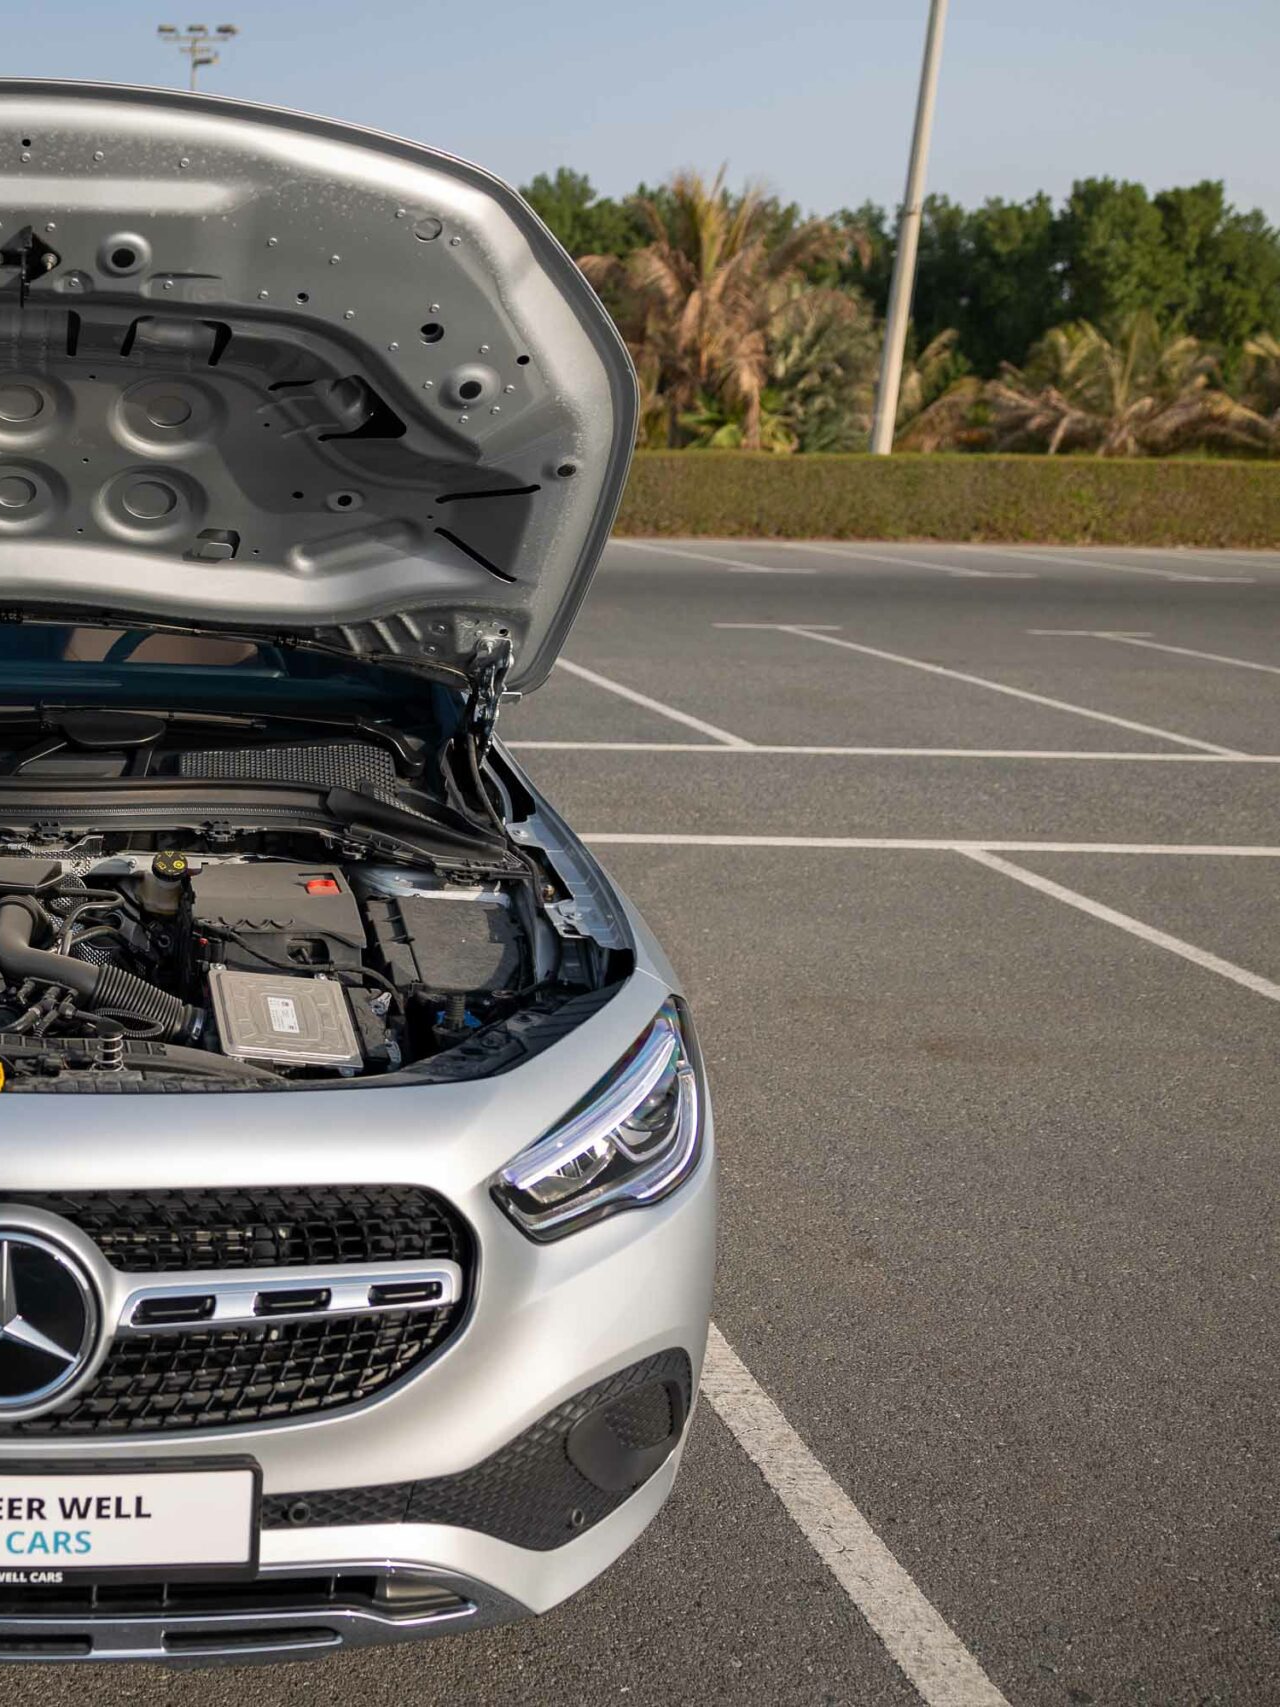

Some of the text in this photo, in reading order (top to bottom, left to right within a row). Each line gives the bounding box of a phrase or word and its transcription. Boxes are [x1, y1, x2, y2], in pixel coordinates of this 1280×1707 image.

[58, 1495, 152, 1520] WELL
[6, 1530, 92, 1554] CARS
[29, 1571, 63, 1583] CARS
